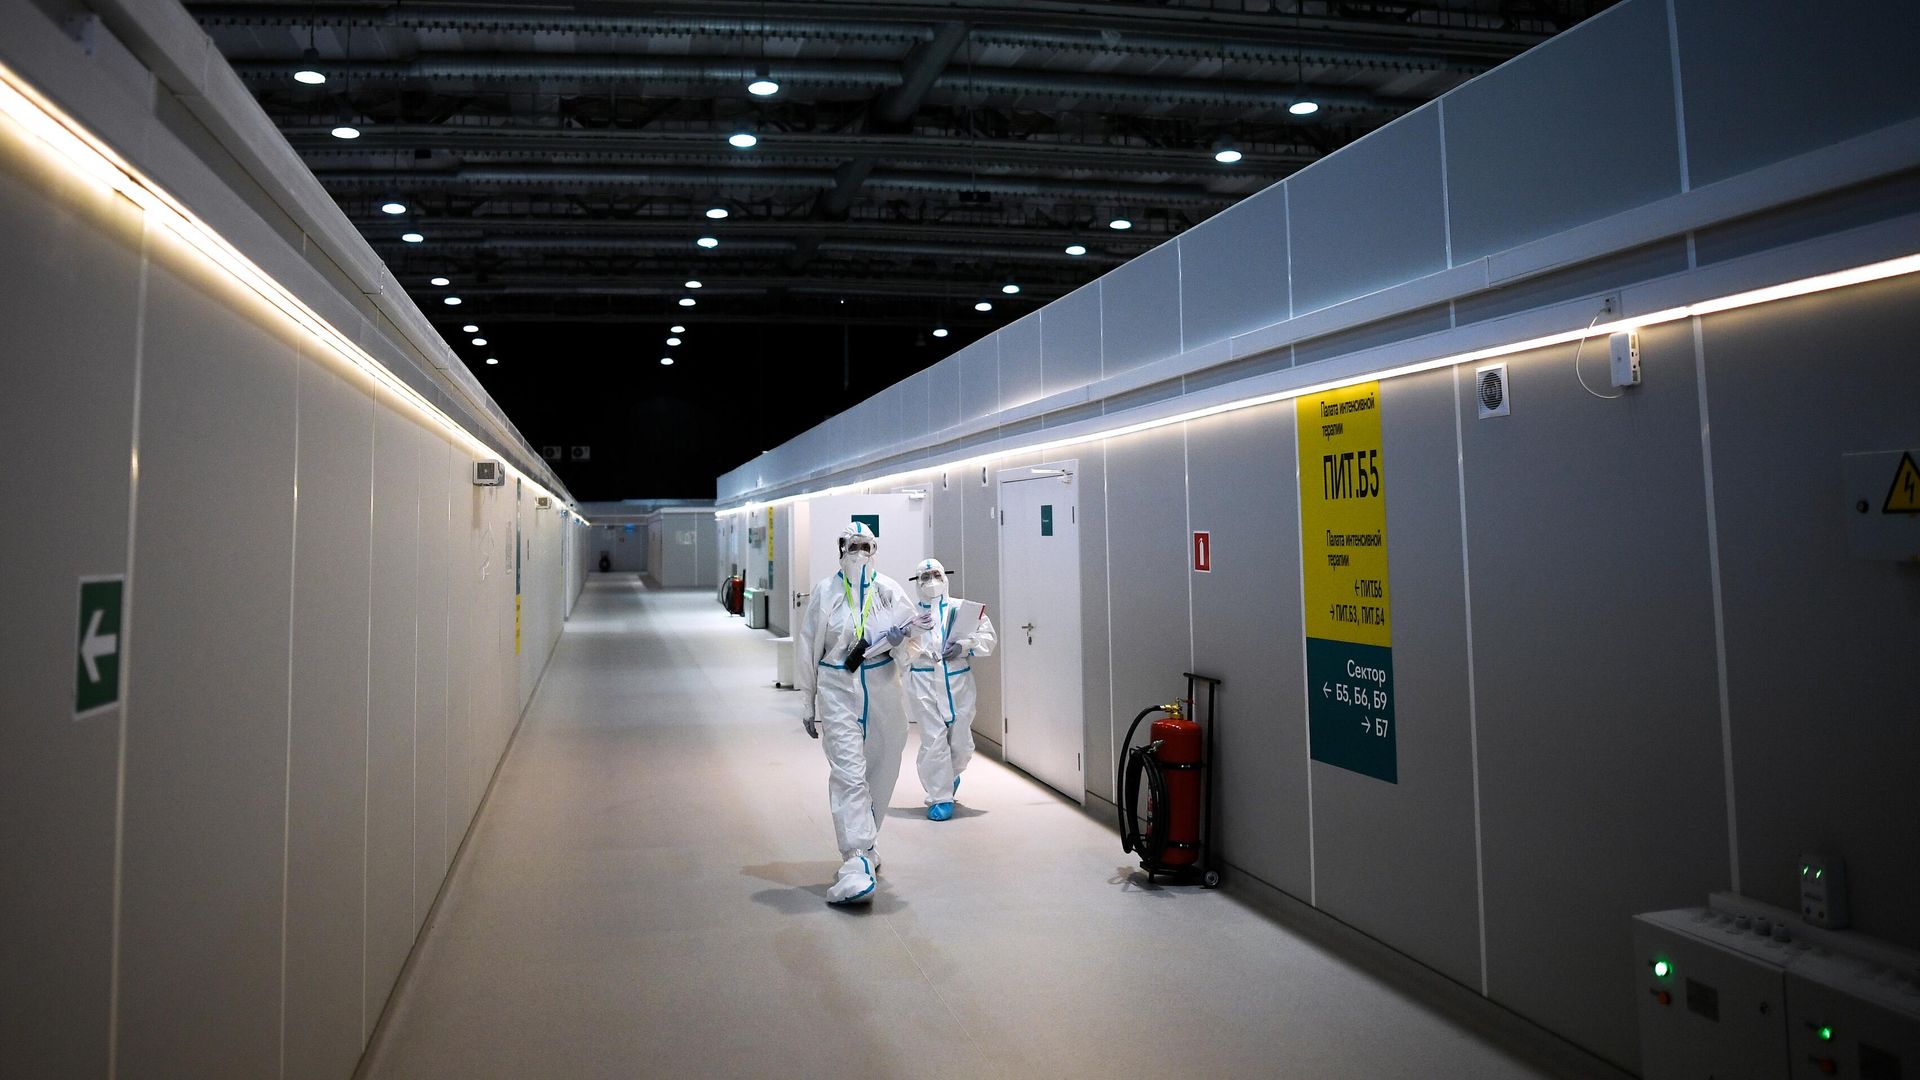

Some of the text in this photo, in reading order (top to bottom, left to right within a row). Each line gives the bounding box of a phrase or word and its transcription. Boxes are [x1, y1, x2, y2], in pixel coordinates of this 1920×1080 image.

[1320, 392, 1375, 418] Палата интенсивной
[1322, 423, 1344, 441] терапии
[1323, 449, 1379, 500] ПИТ.Б5
[1326, 529, 1382, 547] Палата интенсивной
[1328, 554, 1349, 571] терапии
[1360, 579, 1383, 598] ПИТ.Б6
[1335, 604, 1385, 626] ПИТ.Б3, ПИТ.Б4
[1347, 659, 1386, 688] Сектор
[1336, 683, 1387, 710] Б5, Б6, Б9
[1375, 717, 1388, 738] Б7
